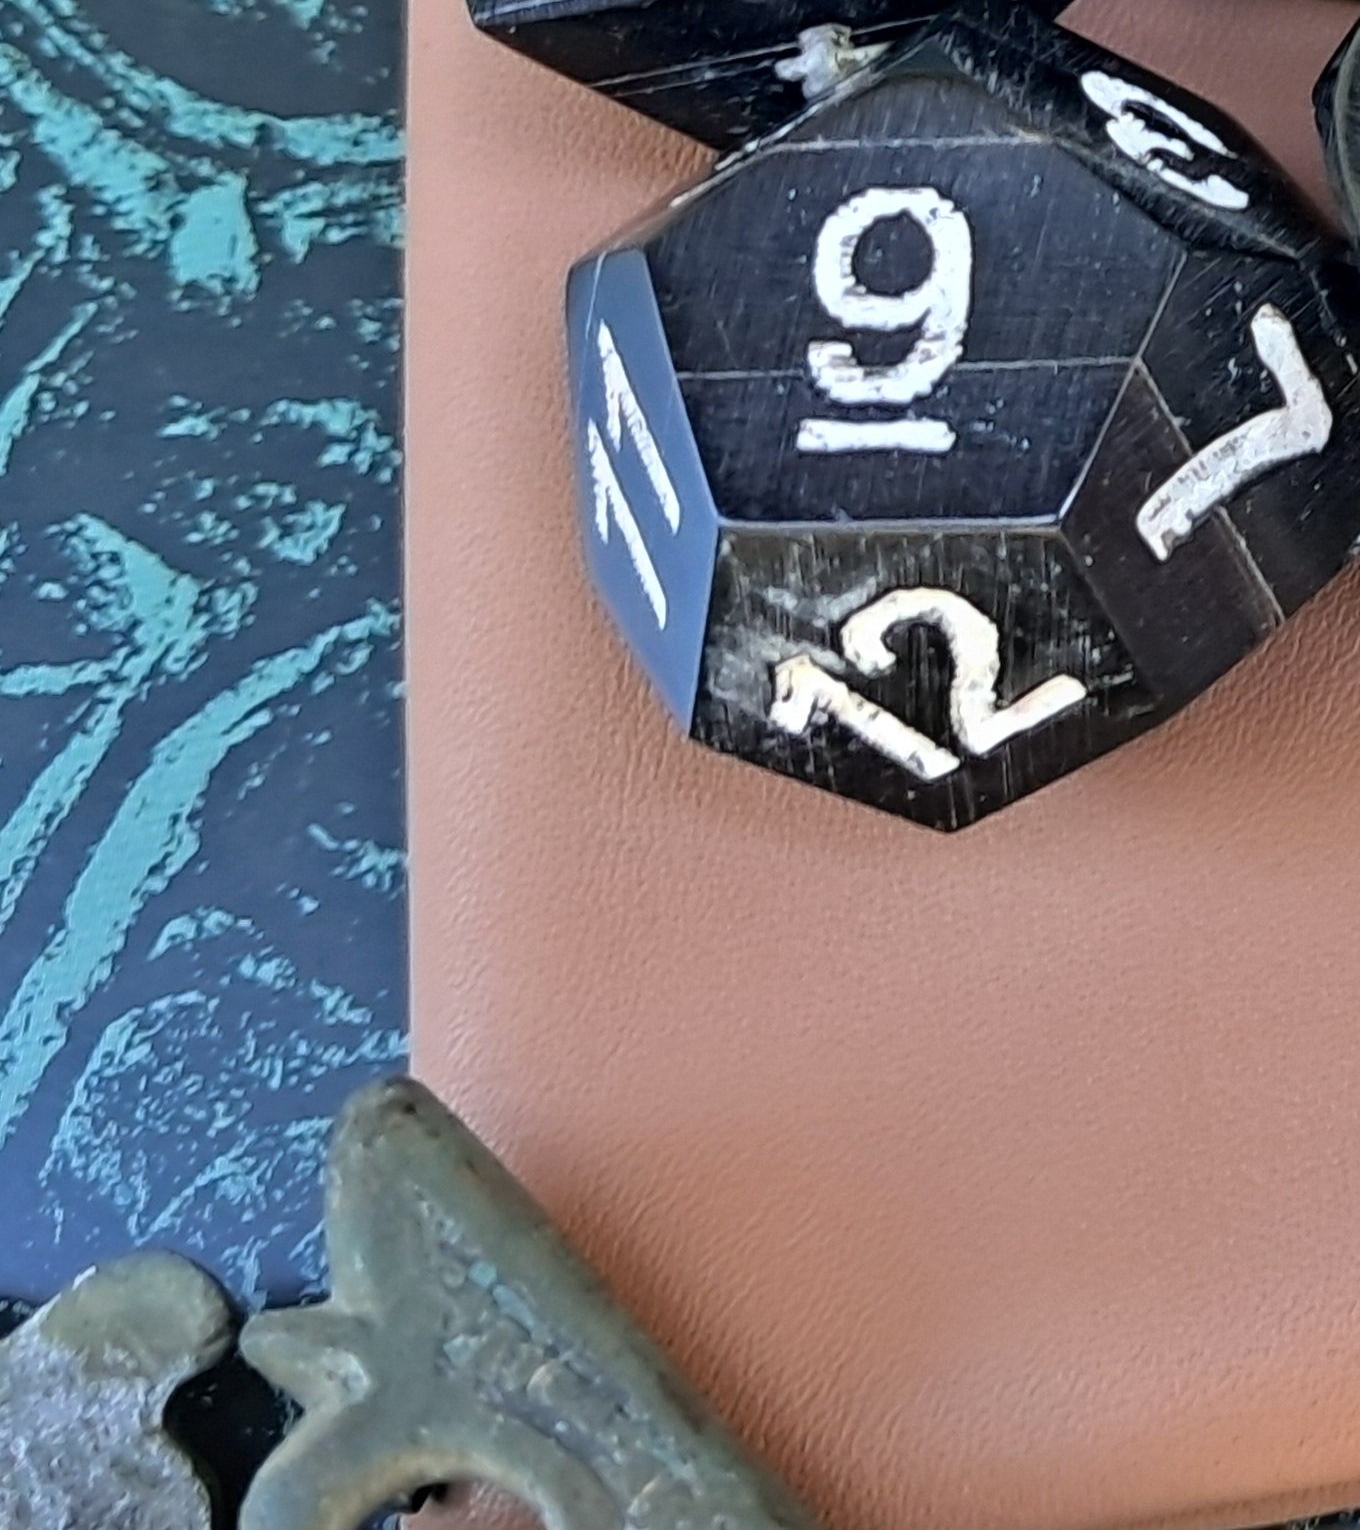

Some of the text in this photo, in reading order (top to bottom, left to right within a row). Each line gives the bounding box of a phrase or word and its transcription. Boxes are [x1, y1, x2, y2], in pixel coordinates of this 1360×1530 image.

[808, 186, 973, 405] 9
[586, 318, 681, 631] 11
[1134, 302, 1334, 562] 7
[769, 585, 1088, 781] 12
